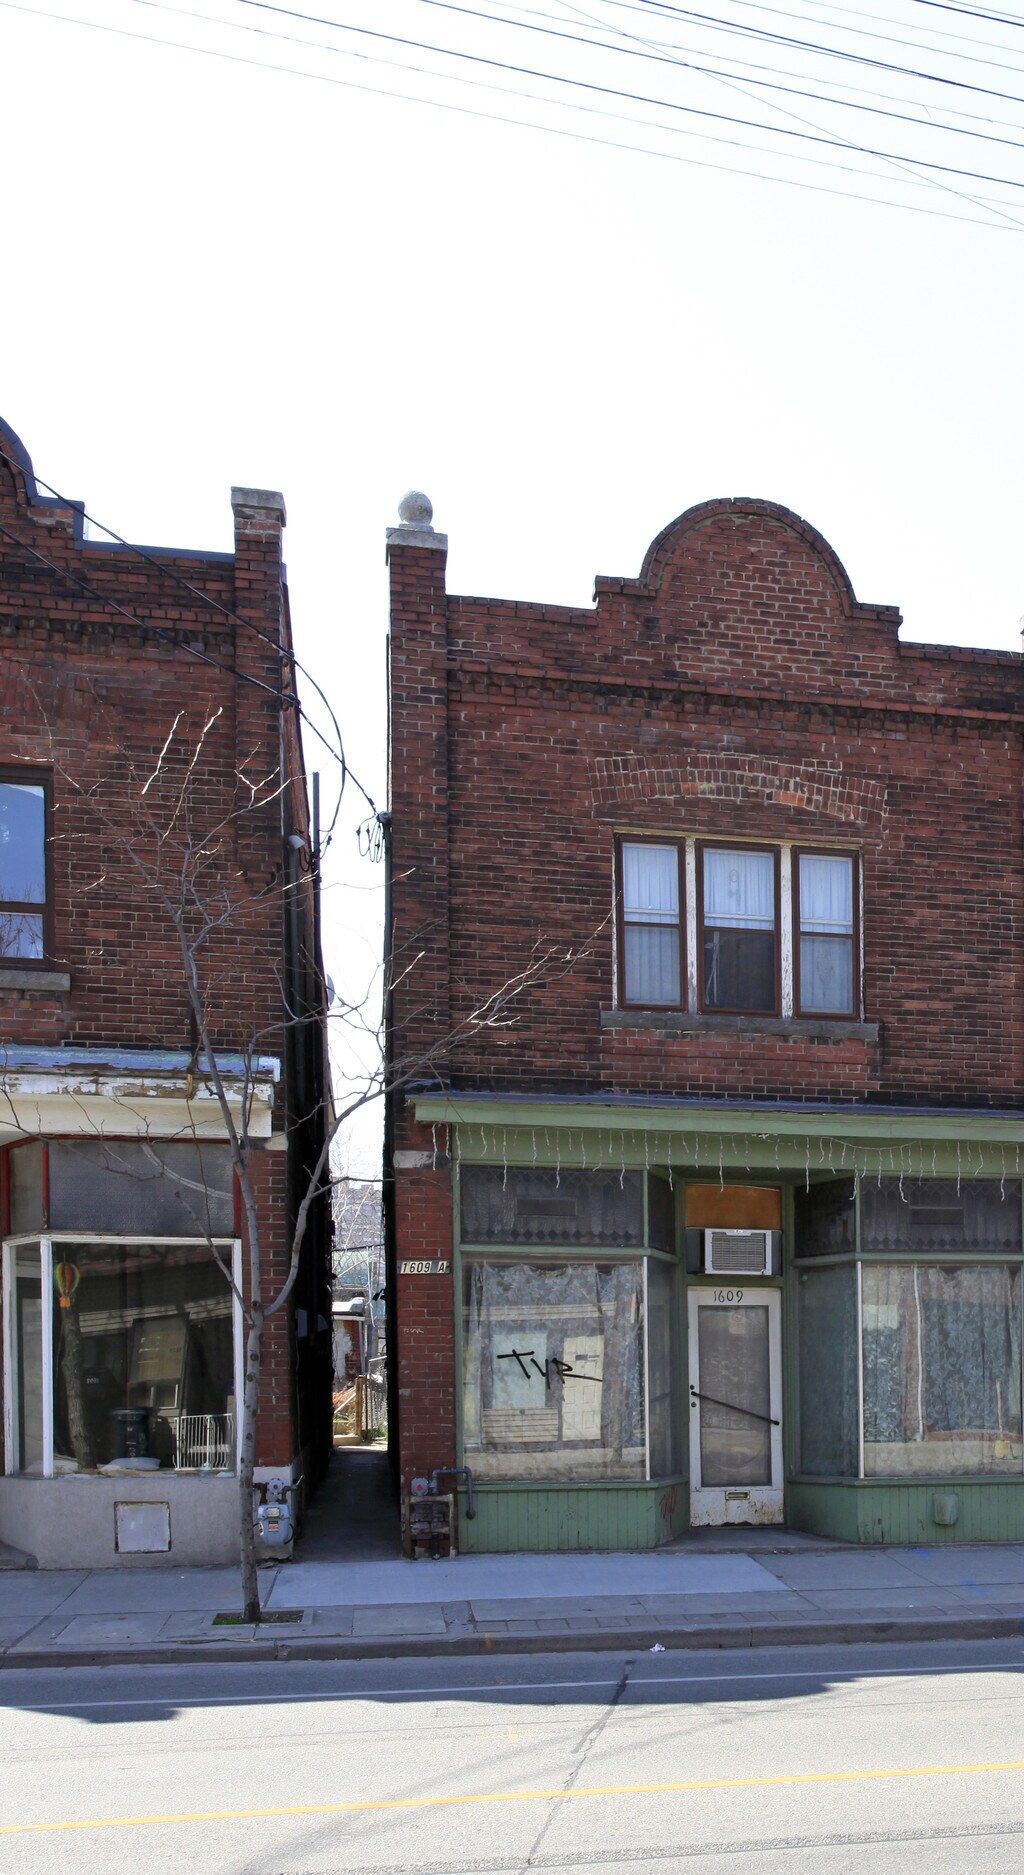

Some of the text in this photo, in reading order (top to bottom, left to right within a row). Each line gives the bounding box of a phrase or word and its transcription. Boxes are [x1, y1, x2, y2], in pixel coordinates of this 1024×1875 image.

[403, 1262, 446, 1273] 1609 A
[713, 1290, 744, 1303] 1609
